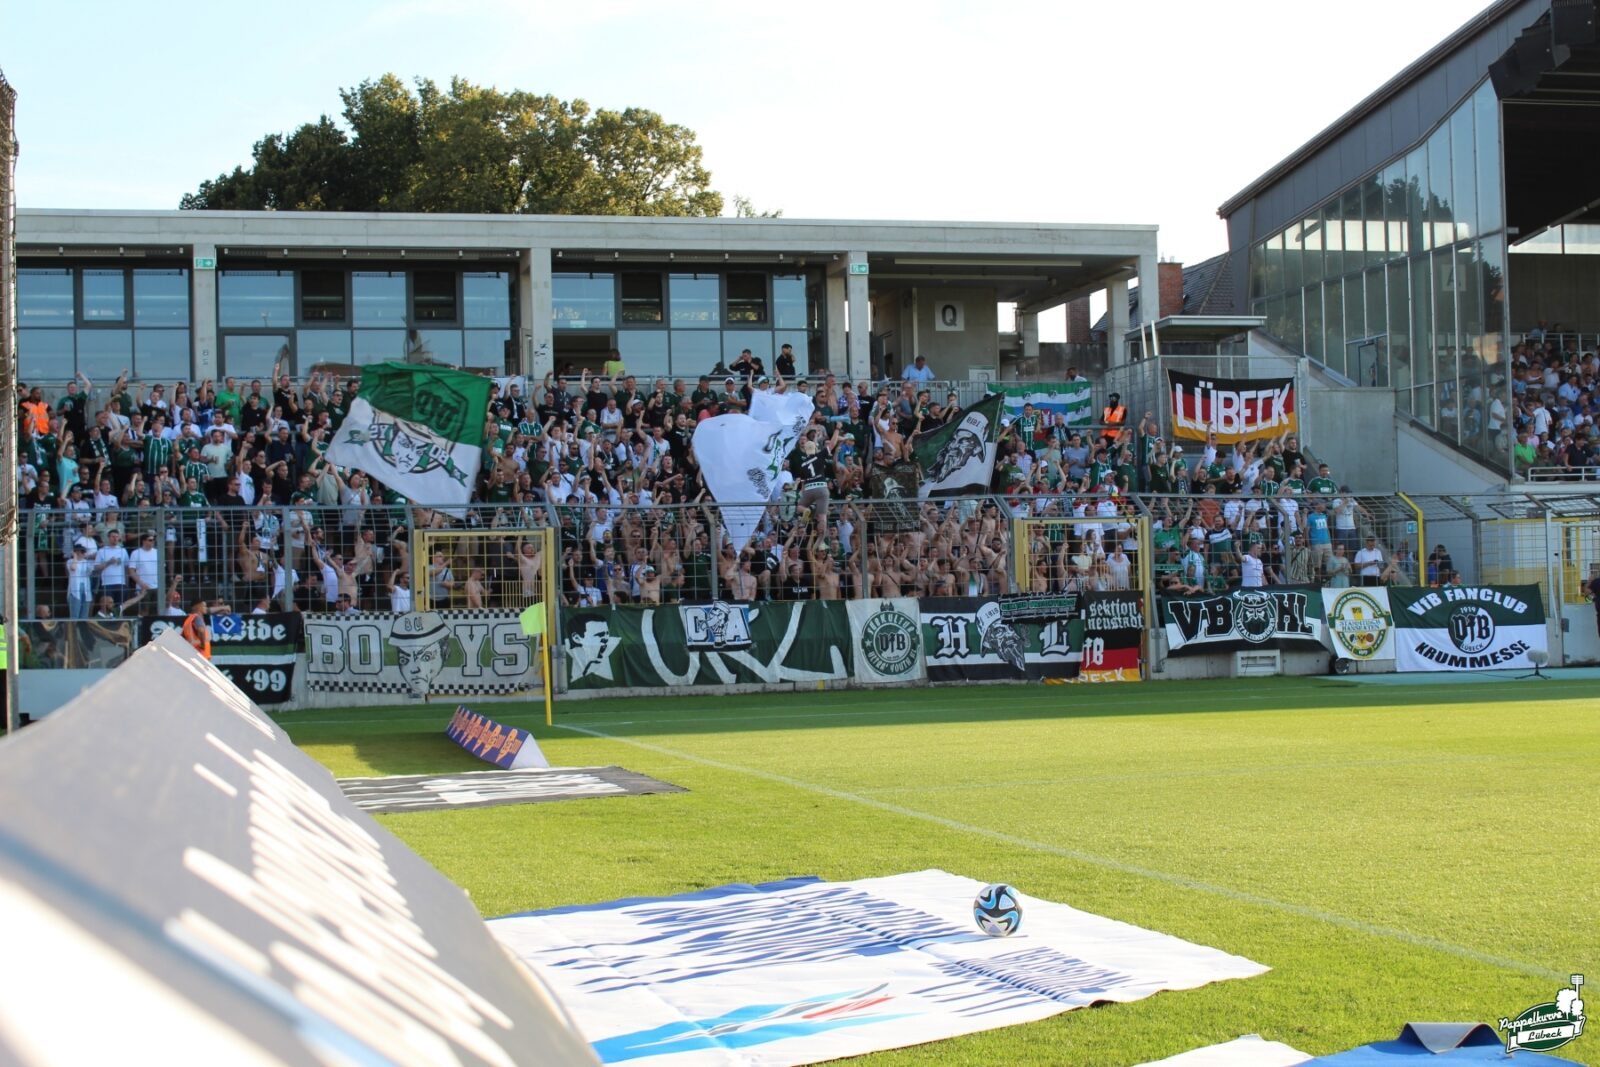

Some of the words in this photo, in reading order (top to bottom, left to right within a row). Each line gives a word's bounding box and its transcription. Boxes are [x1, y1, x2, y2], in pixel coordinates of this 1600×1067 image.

[941, 304, 957, 327] Q
[1175, 381, 1291, 434] LÜBECK
[1407, 592, 1442, 616] VfB
[1444, 587, 1528, 614] FANCLUB
[1460, 606, 1476, 614] 1919
[1083, 637, 1104, 668] fB
[1415, 640, 1531, 669] KRUMMESSE
